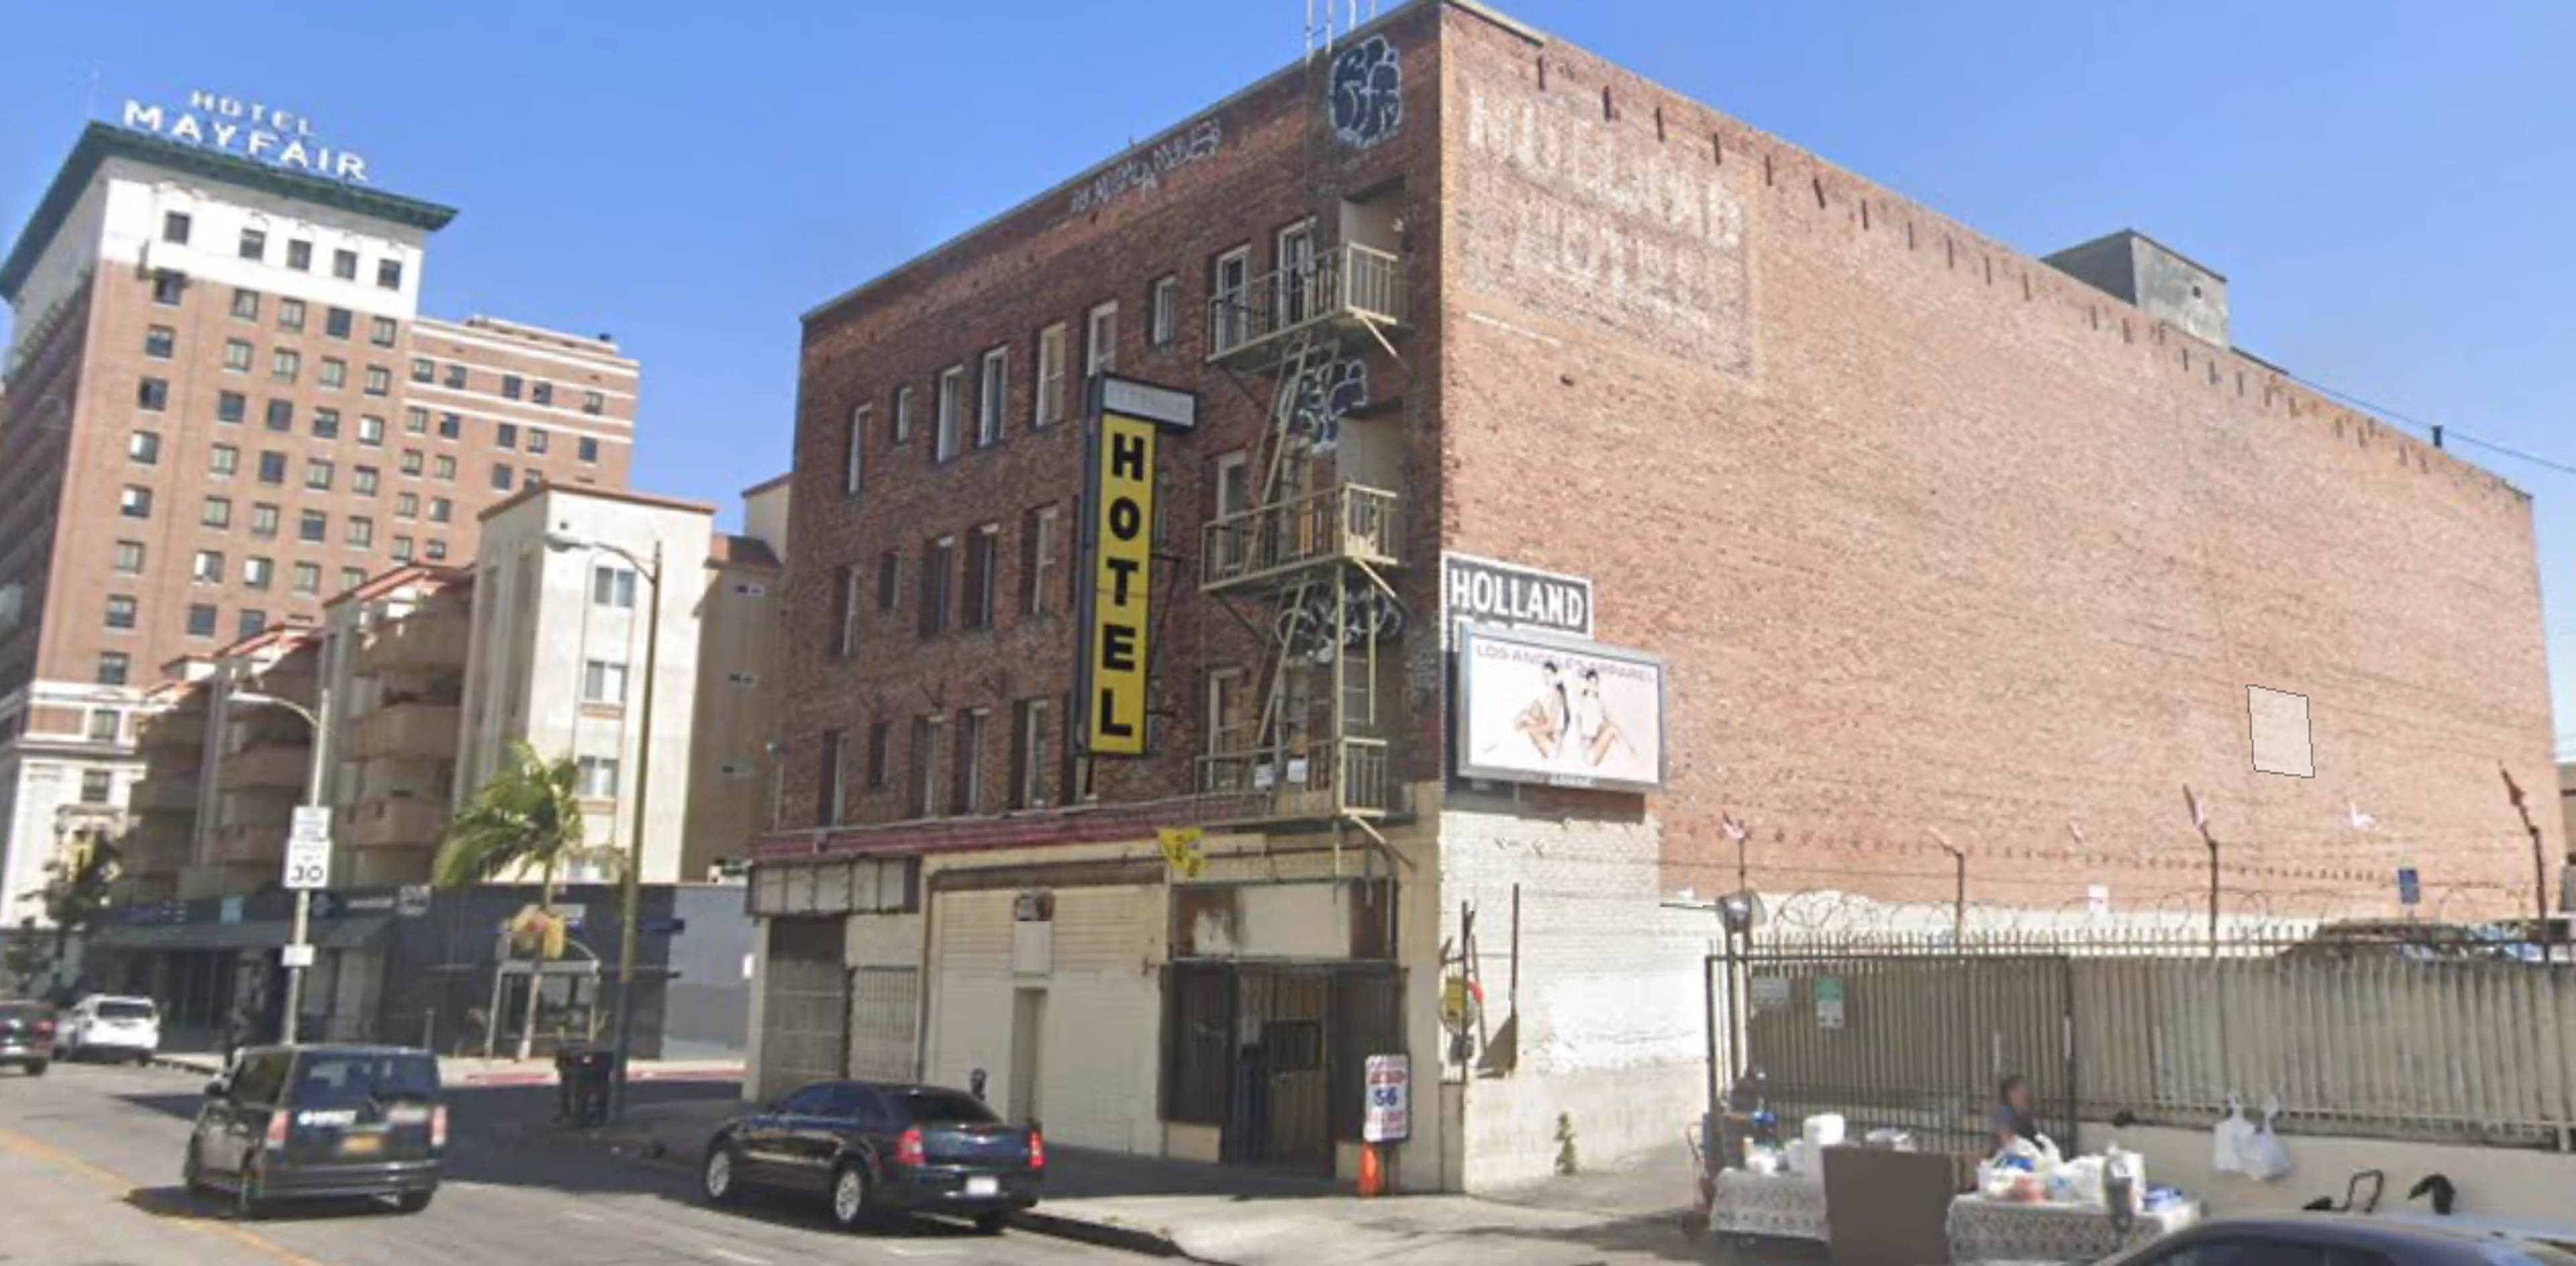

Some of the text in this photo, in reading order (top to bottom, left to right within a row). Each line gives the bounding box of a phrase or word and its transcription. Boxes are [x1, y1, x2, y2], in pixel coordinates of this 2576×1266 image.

[192, 89, 315, 136] HOTEL
[123, 99, 367, 182] MAYFAIR
[1100, 433, 1144, 737] HOTEL
[1450, 568, 1585, 627] HOLLAND
[1477, 643, 1509, 660] LOS
[1512, 649, 1584, 673] ANGELES
[290, 864, 324, 882] 30
